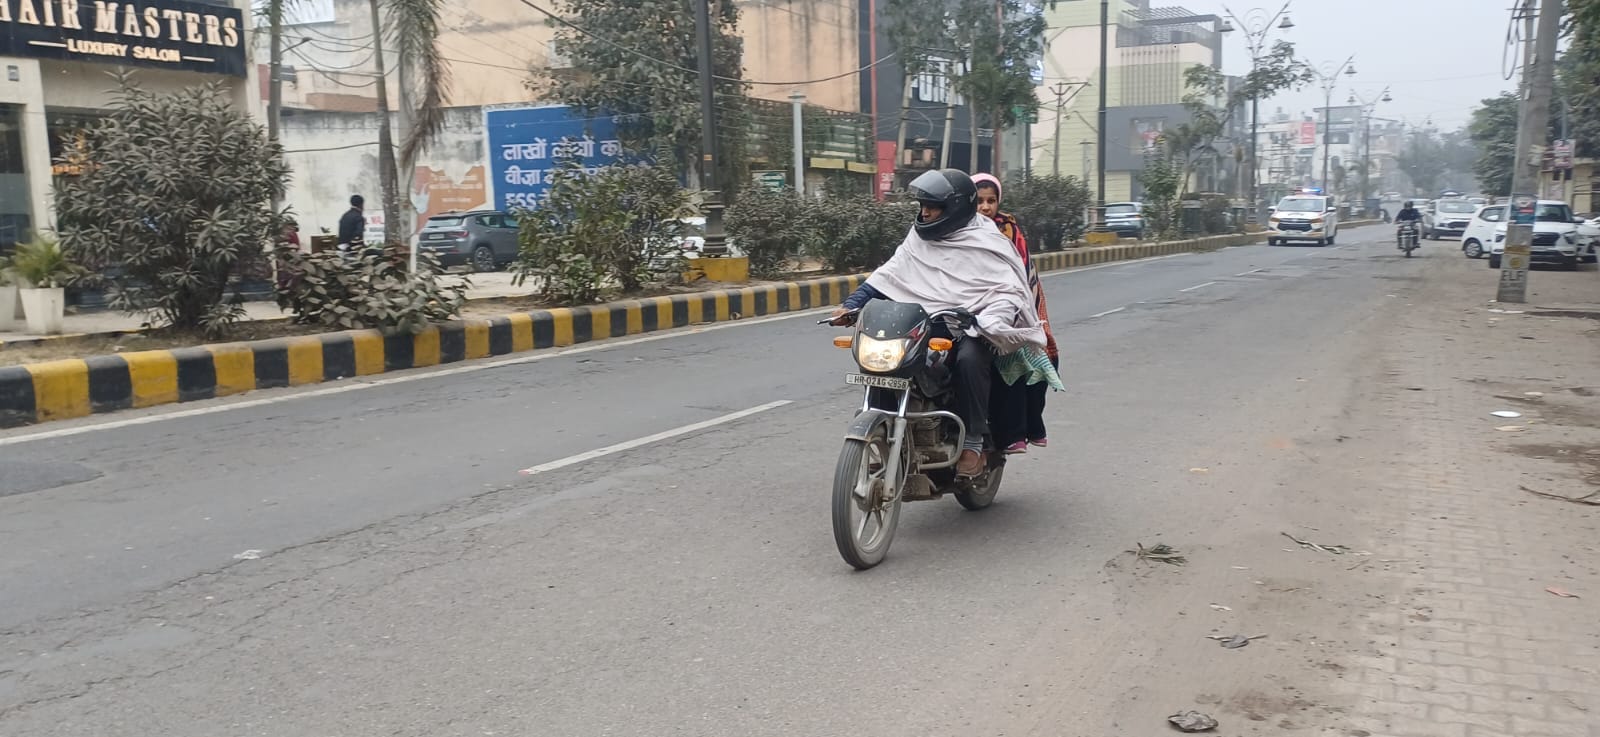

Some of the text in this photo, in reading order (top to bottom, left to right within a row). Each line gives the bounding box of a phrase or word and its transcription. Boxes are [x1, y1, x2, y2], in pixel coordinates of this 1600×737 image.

[93, 0, 239, 47] MASTERS
[66, 38, 181, 62] LUXURY SALON
[501, 137, 547, 161] लाखों
